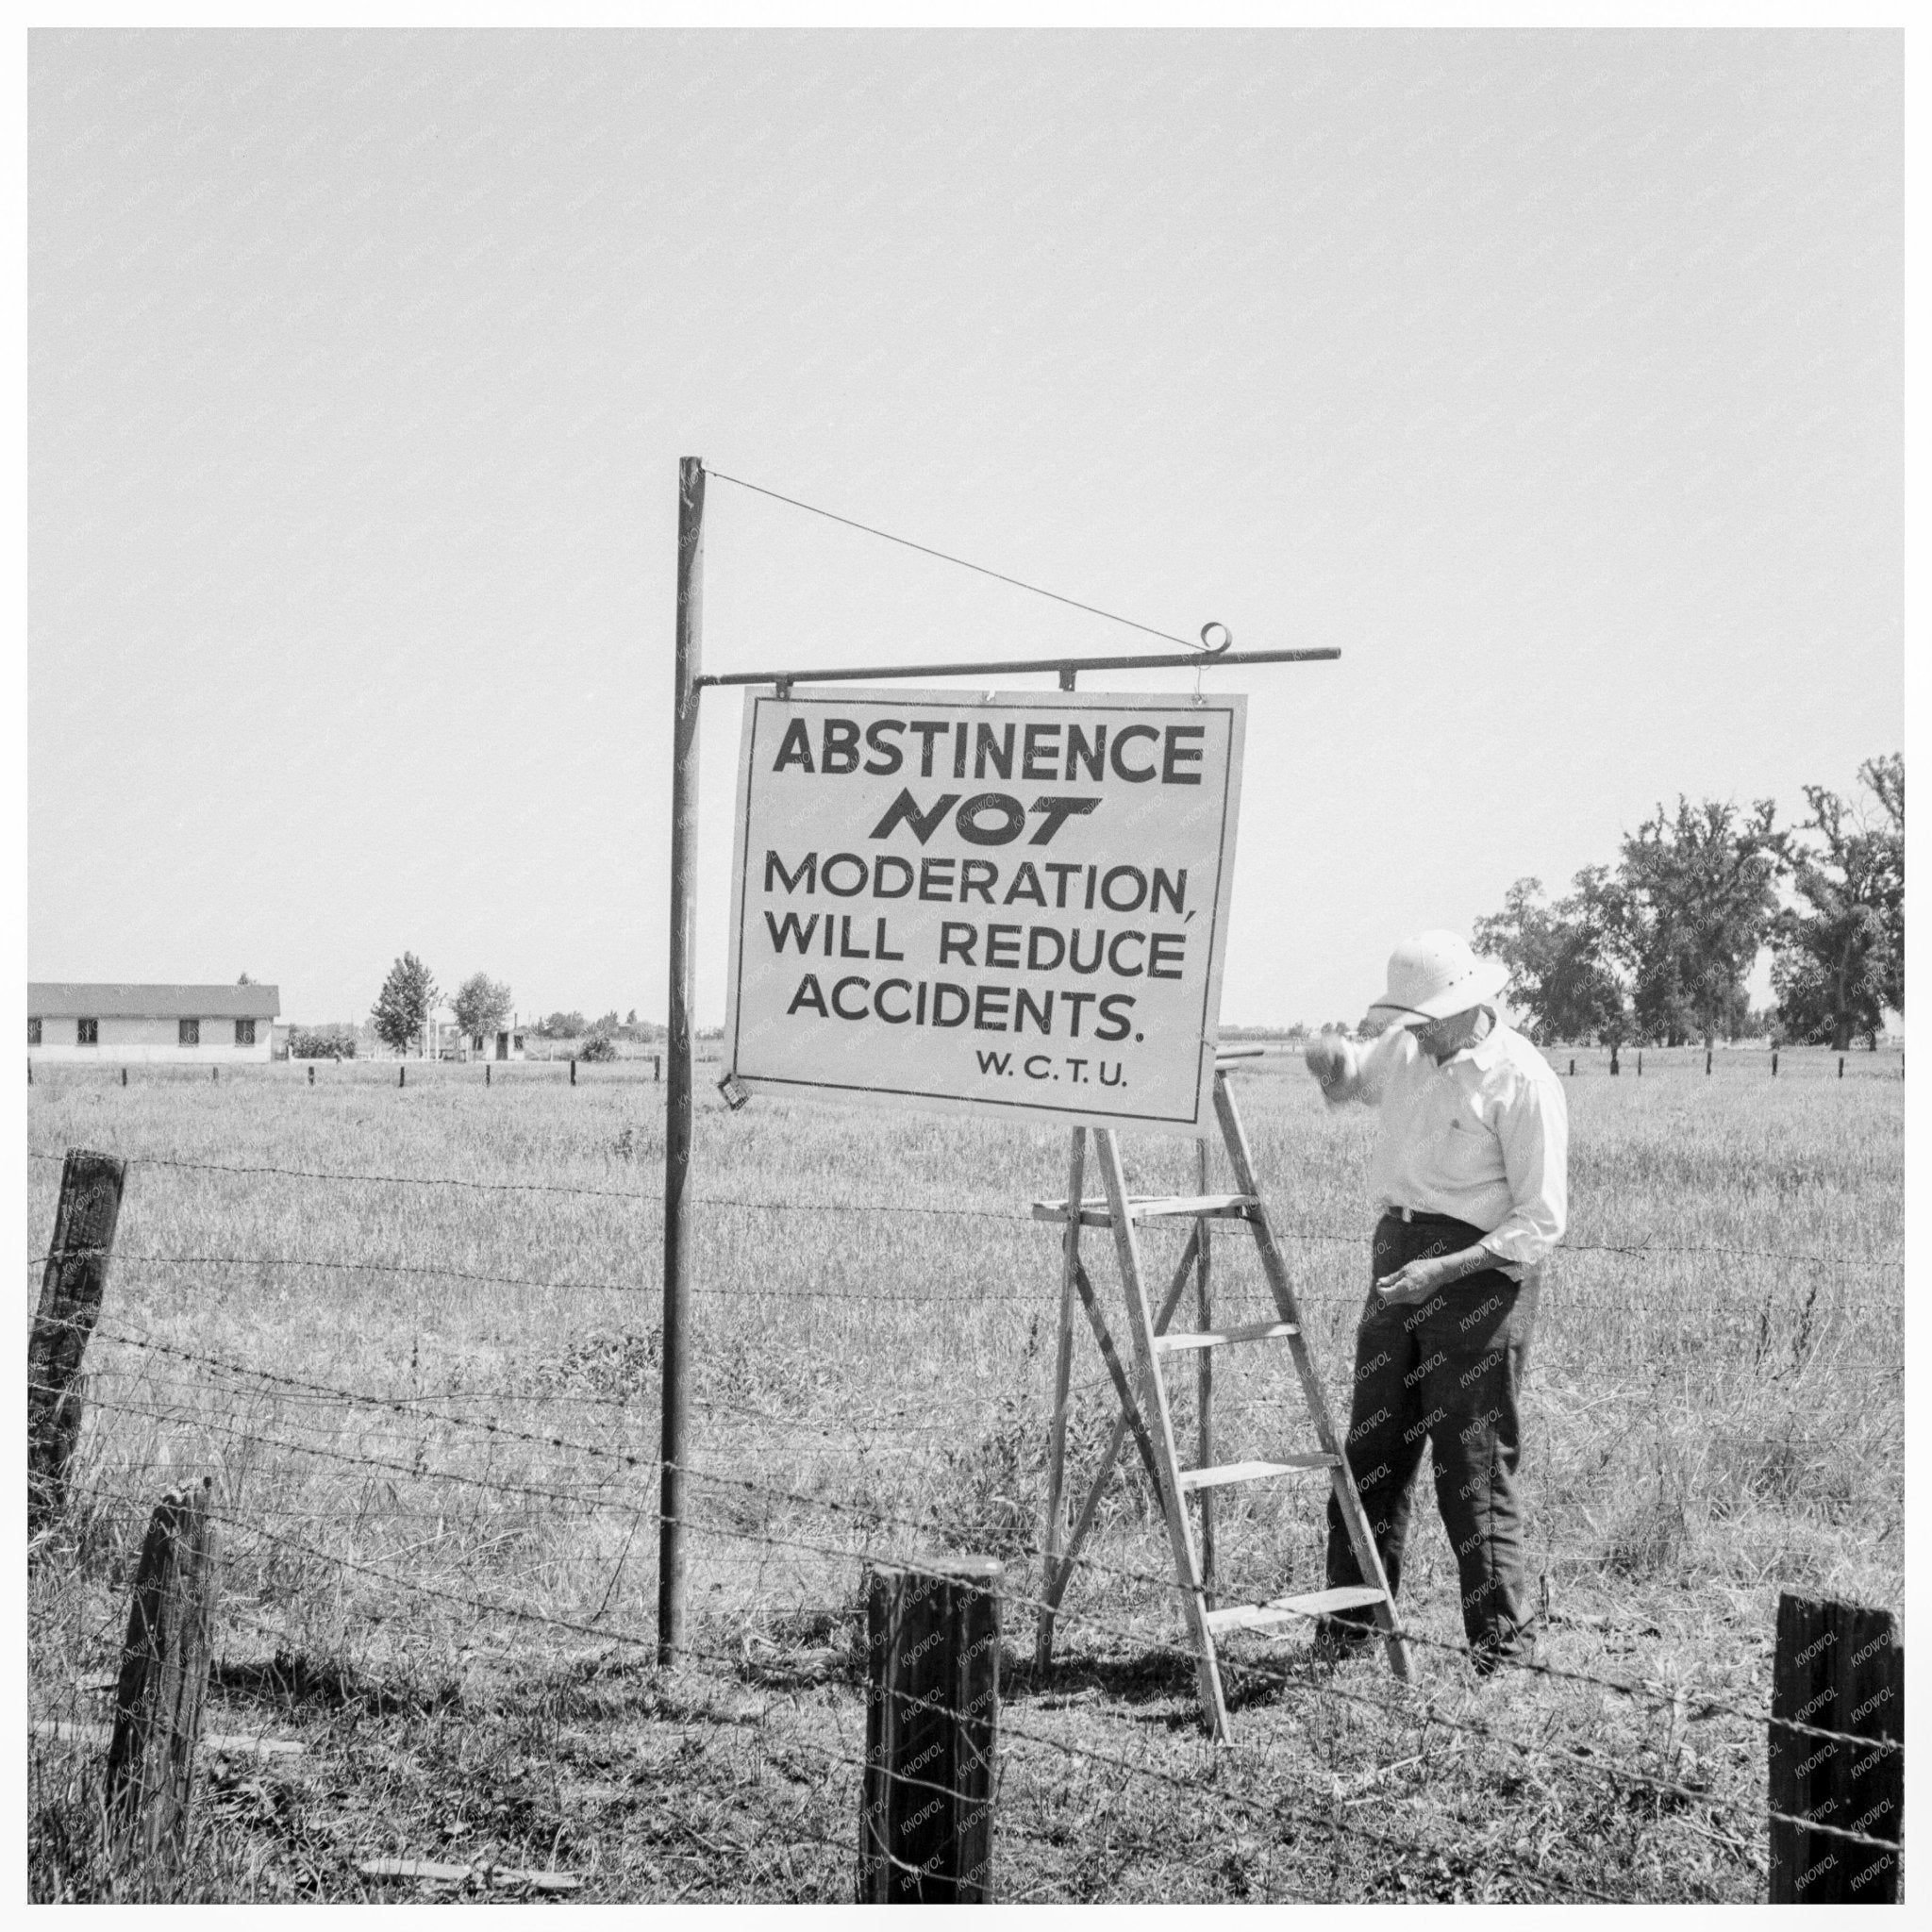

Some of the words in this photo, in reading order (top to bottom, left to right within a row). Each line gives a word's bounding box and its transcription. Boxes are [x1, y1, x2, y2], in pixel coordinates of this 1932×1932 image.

[773, 718, 1205, 785] ABSTINENCE
[869, 788, 1104, 846] NOT
[764, 850, 1196, 924] MODERATION,
[764, 910, 904, 961] WILL
[940, 921, 1186, 980] REDUCE
[787, 974, 1144, 1042] ACCIDENTS.
